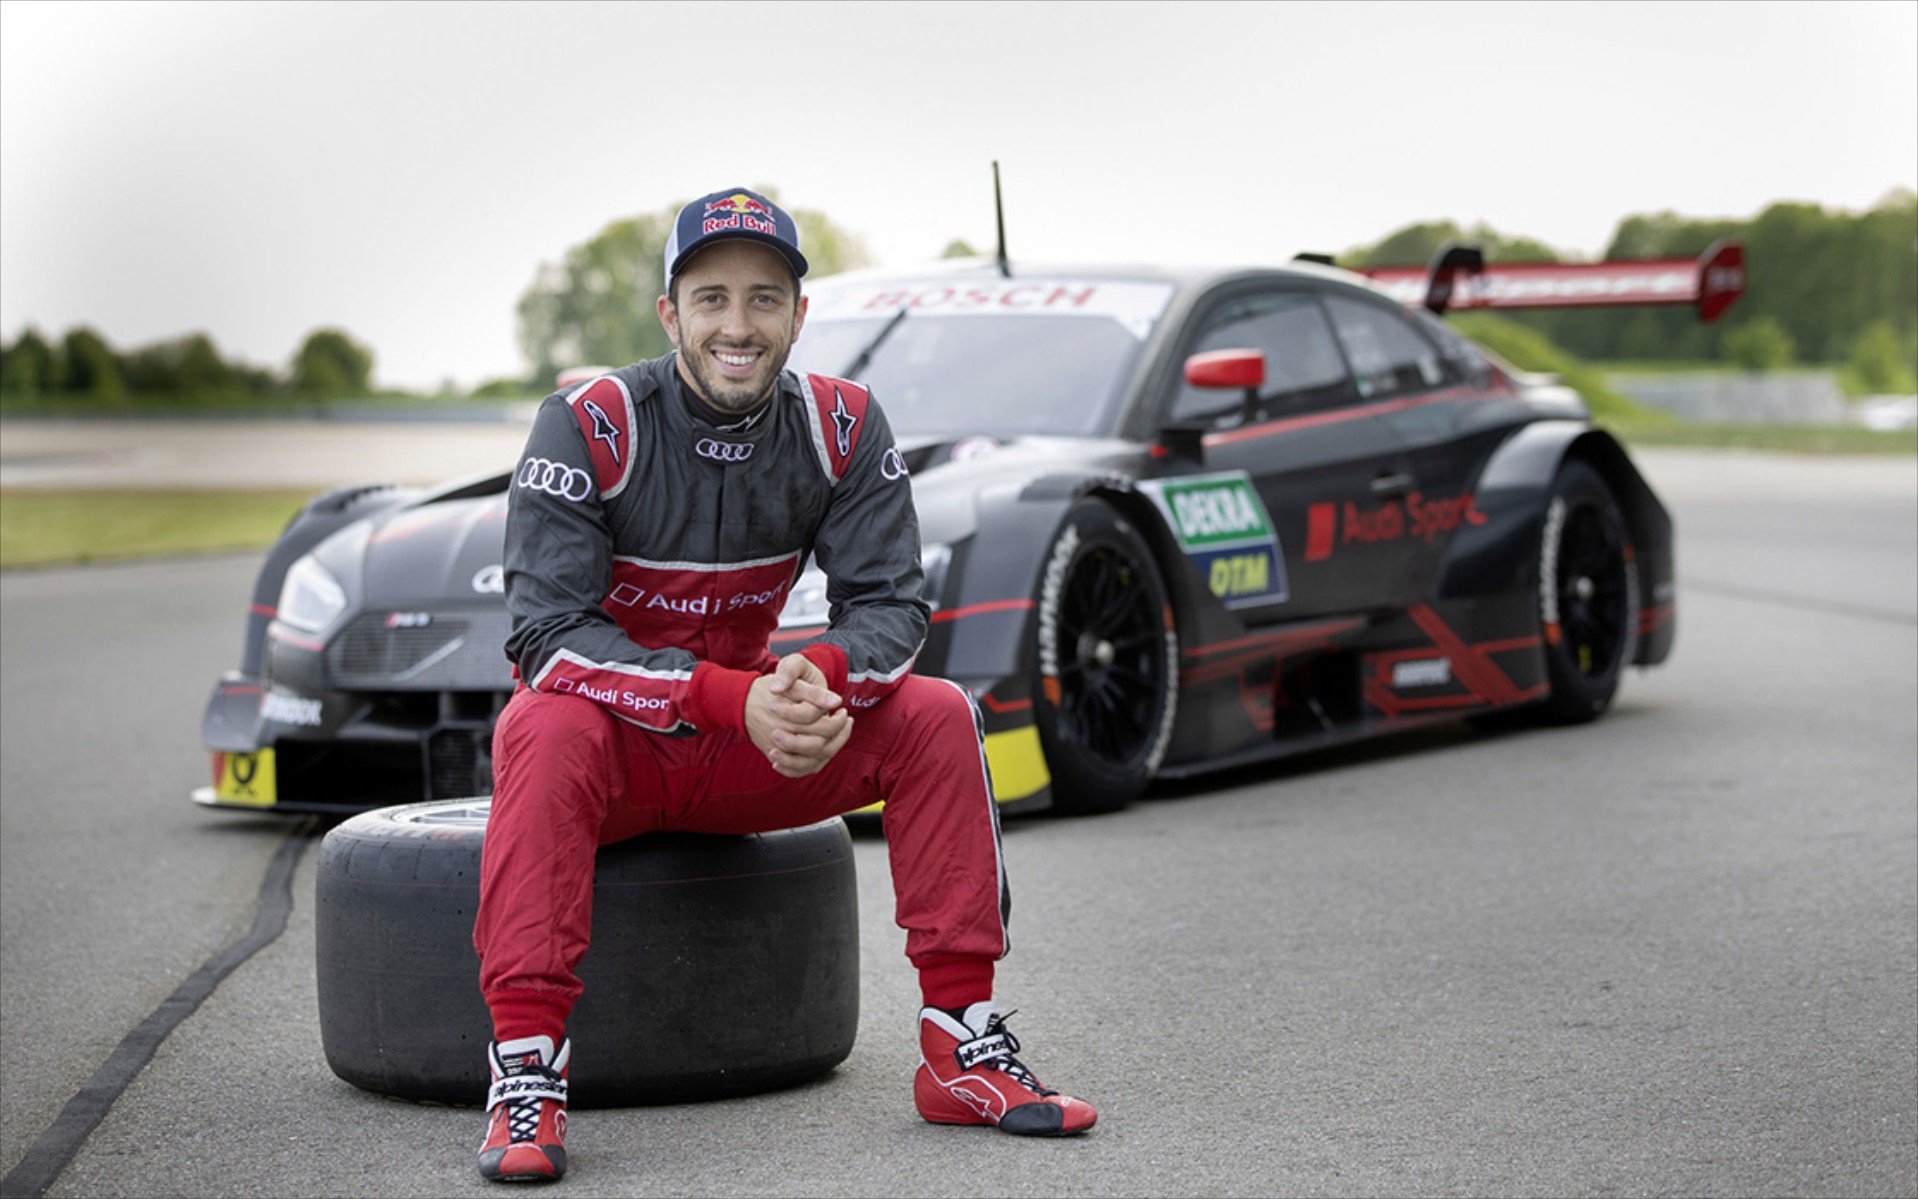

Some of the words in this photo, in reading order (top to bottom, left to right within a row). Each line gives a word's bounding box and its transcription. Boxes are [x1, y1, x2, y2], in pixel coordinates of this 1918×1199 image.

[704, 214, 739, 234] Red
[743, 216, 776, 235] Bull
[1171, 487, 1261, 538] DEKRA
[1342, 501, 1404, 544] Audi
[1406, 492, 1487, 543] Sport
[1209, 555, 1269, 597] DTM
[646, 594, 722, 615] Audi
[727, 580, 786, 612] Sport
[576, 681, 618, 705] Audi
[622, 691, 670, 711] Spor
